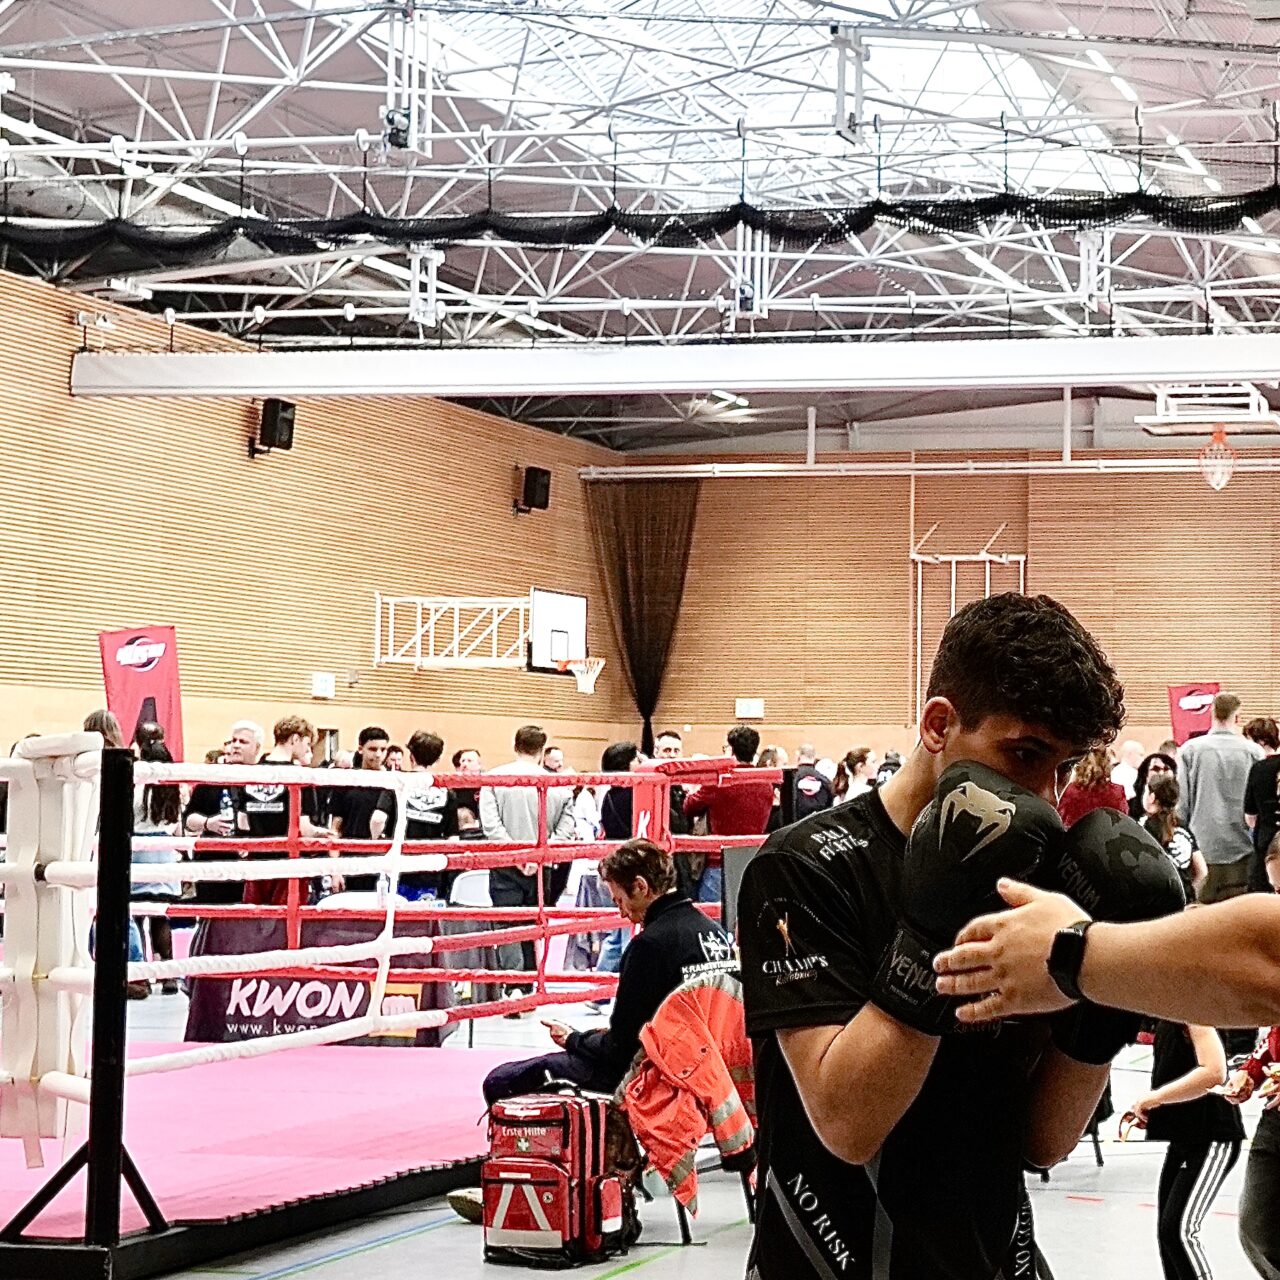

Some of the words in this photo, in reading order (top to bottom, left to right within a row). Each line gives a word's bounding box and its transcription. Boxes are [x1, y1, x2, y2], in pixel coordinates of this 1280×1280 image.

[889, 947, 936, 990] VENU
[225, 978, 365, 1019] KWON
[502, 1126, 522, 1138] Erste
[787, 1172, 819, 1212] NO
[812, 1213, 856, 1271] RISK
